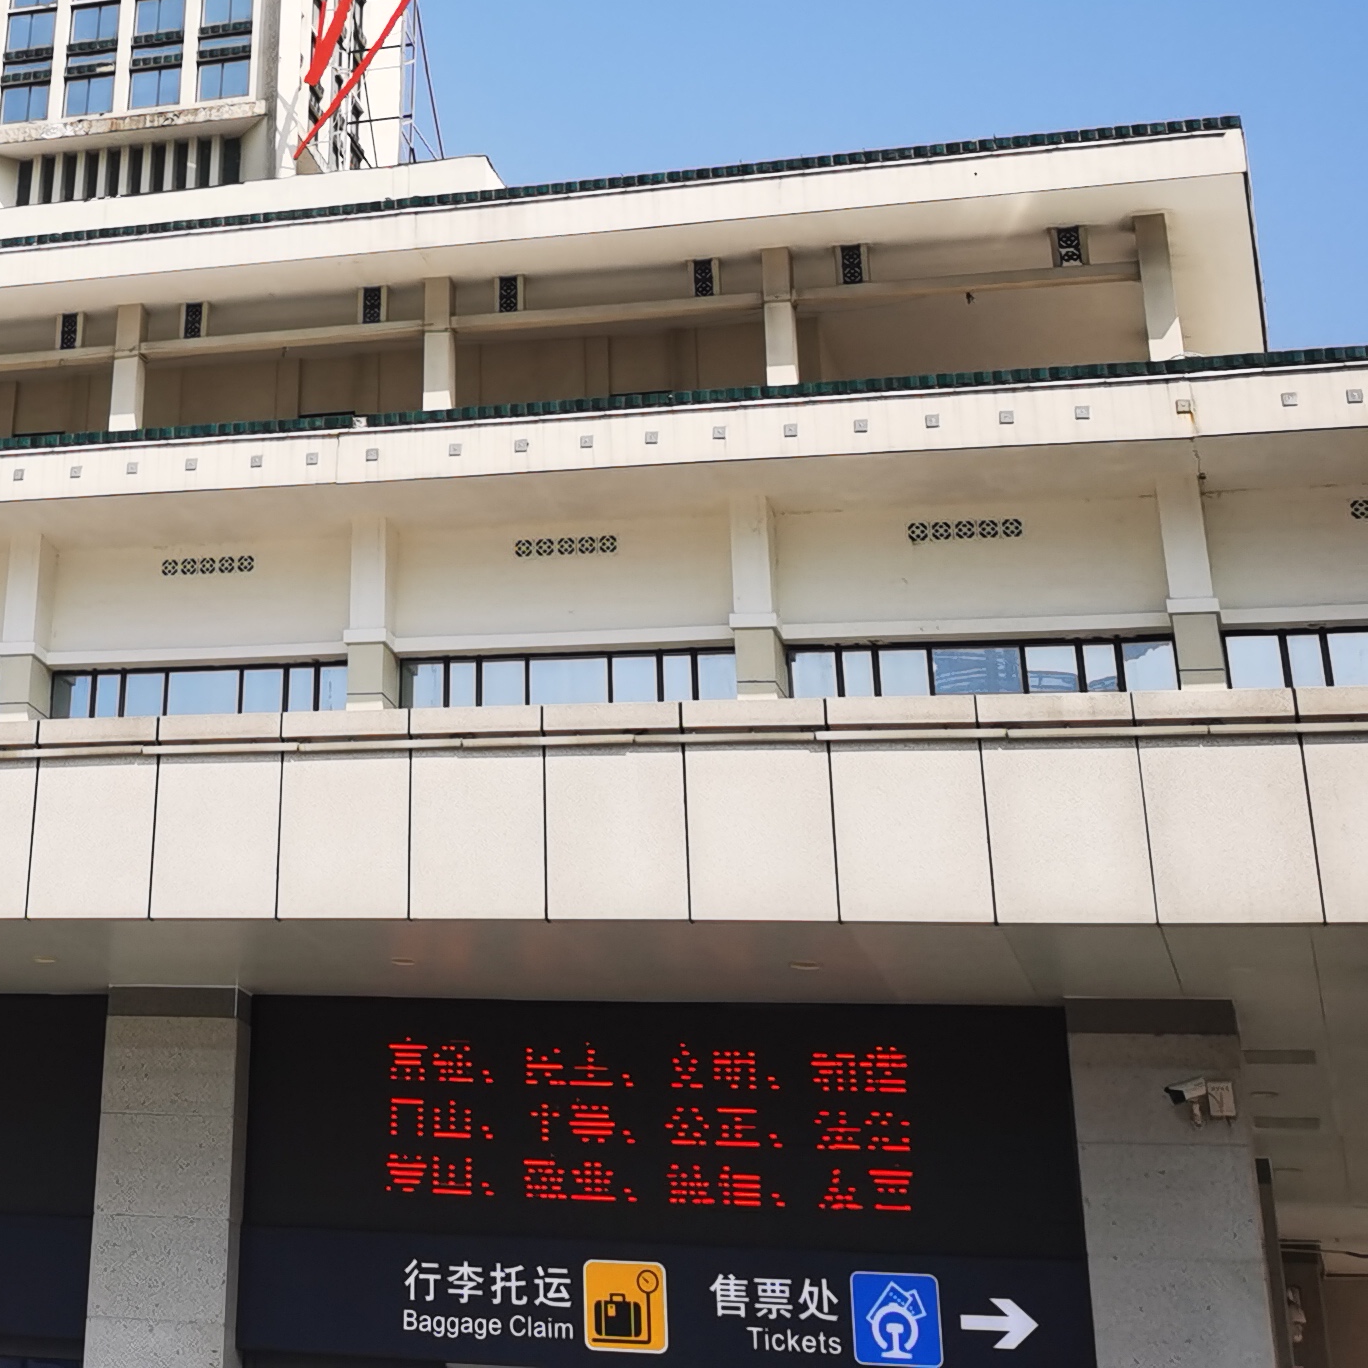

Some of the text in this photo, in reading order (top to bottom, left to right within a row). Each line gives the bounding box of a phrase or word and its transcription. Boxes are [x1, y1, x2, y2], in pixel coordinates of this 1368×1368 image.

[404, 1258, 573, 1308] 行李托运
[709, 1273, 840, 1322] 售票处
[403, 1310, 574, 1341] Baggage Claim
[746, 1326, 842, 1355] Tickets
